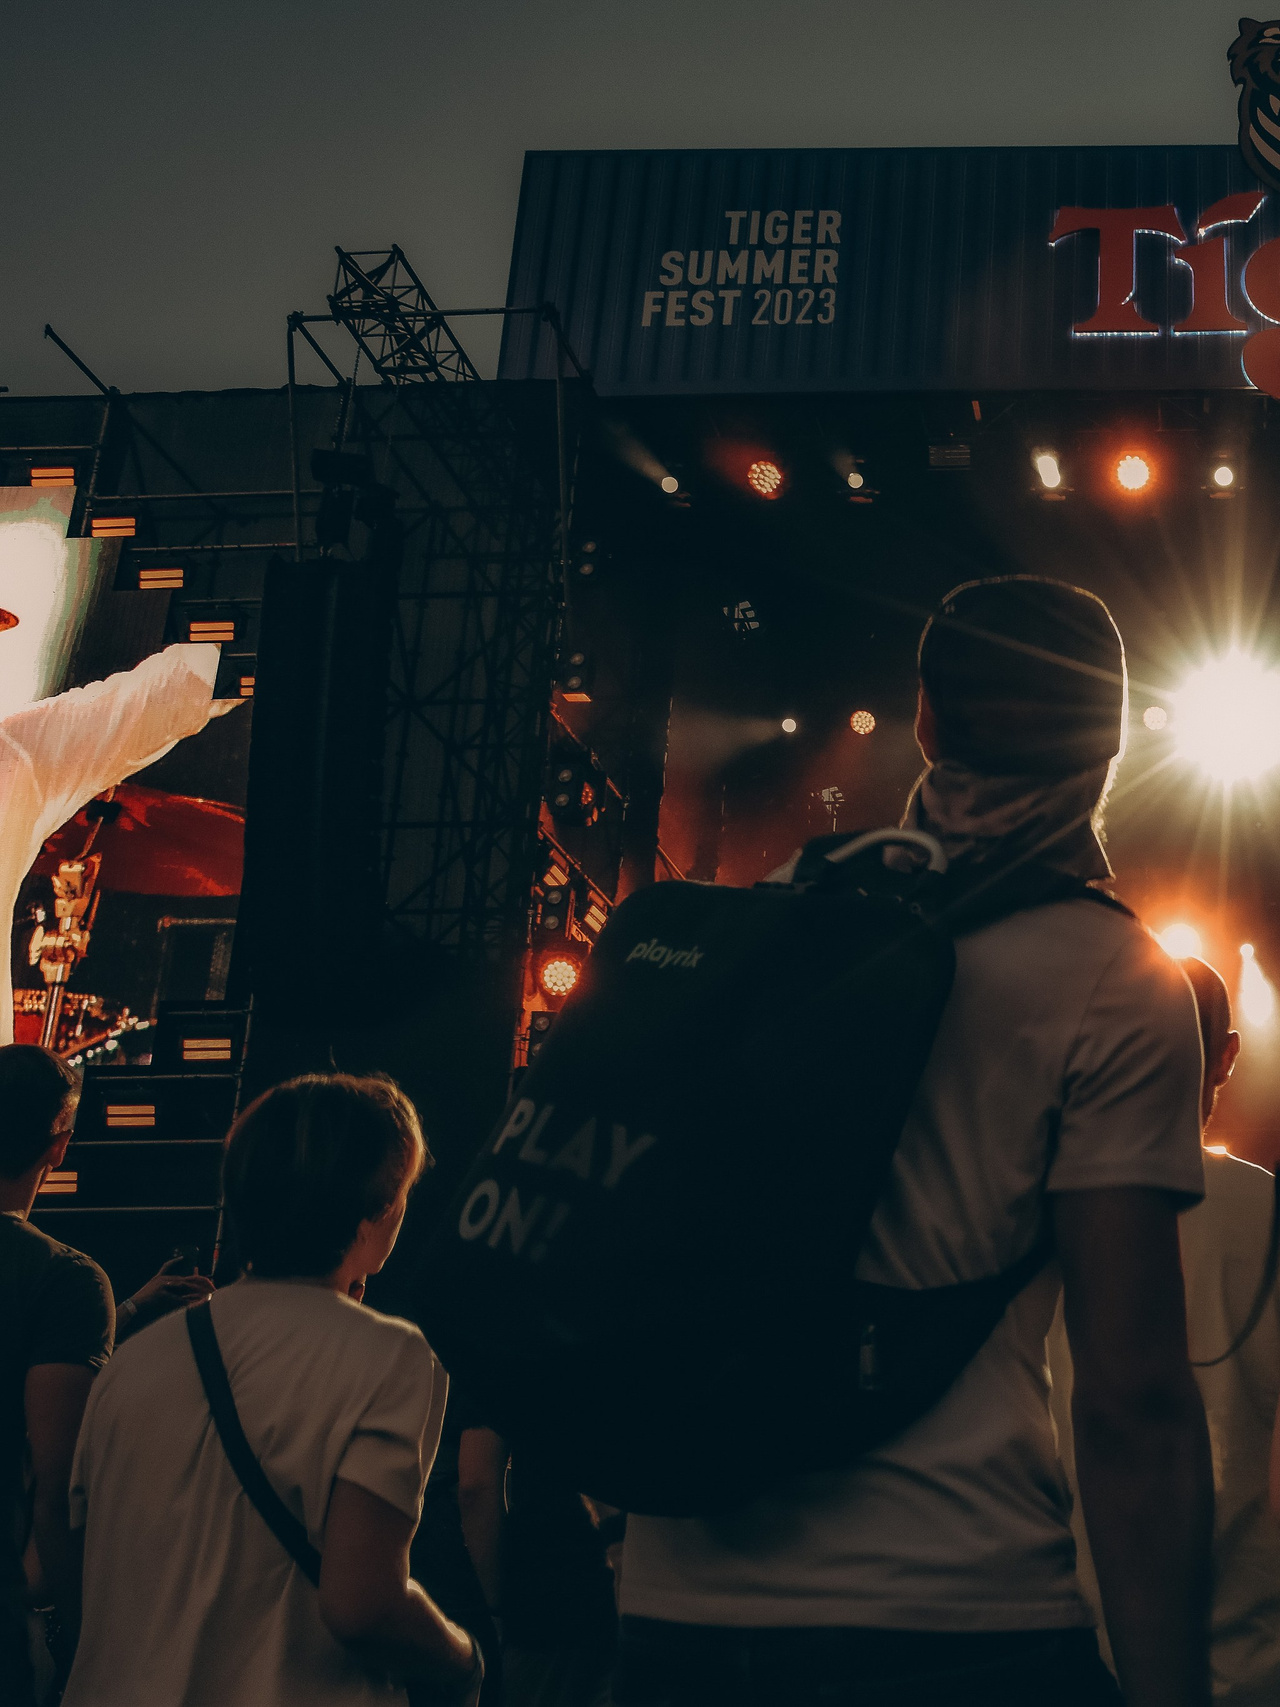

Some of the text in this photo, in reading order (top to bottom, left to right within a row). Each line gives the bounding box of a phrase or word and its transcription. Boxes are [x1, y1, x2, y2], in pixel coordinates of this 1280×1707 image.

[724, 209, 842, 245] TIGER
[659, 248, 839, 286] SUMMER
[641, 288, 836, 327] FEST 2023
[625, 937, 705, 969] playrix
[492, 1097, 658, 1189] PLAY
